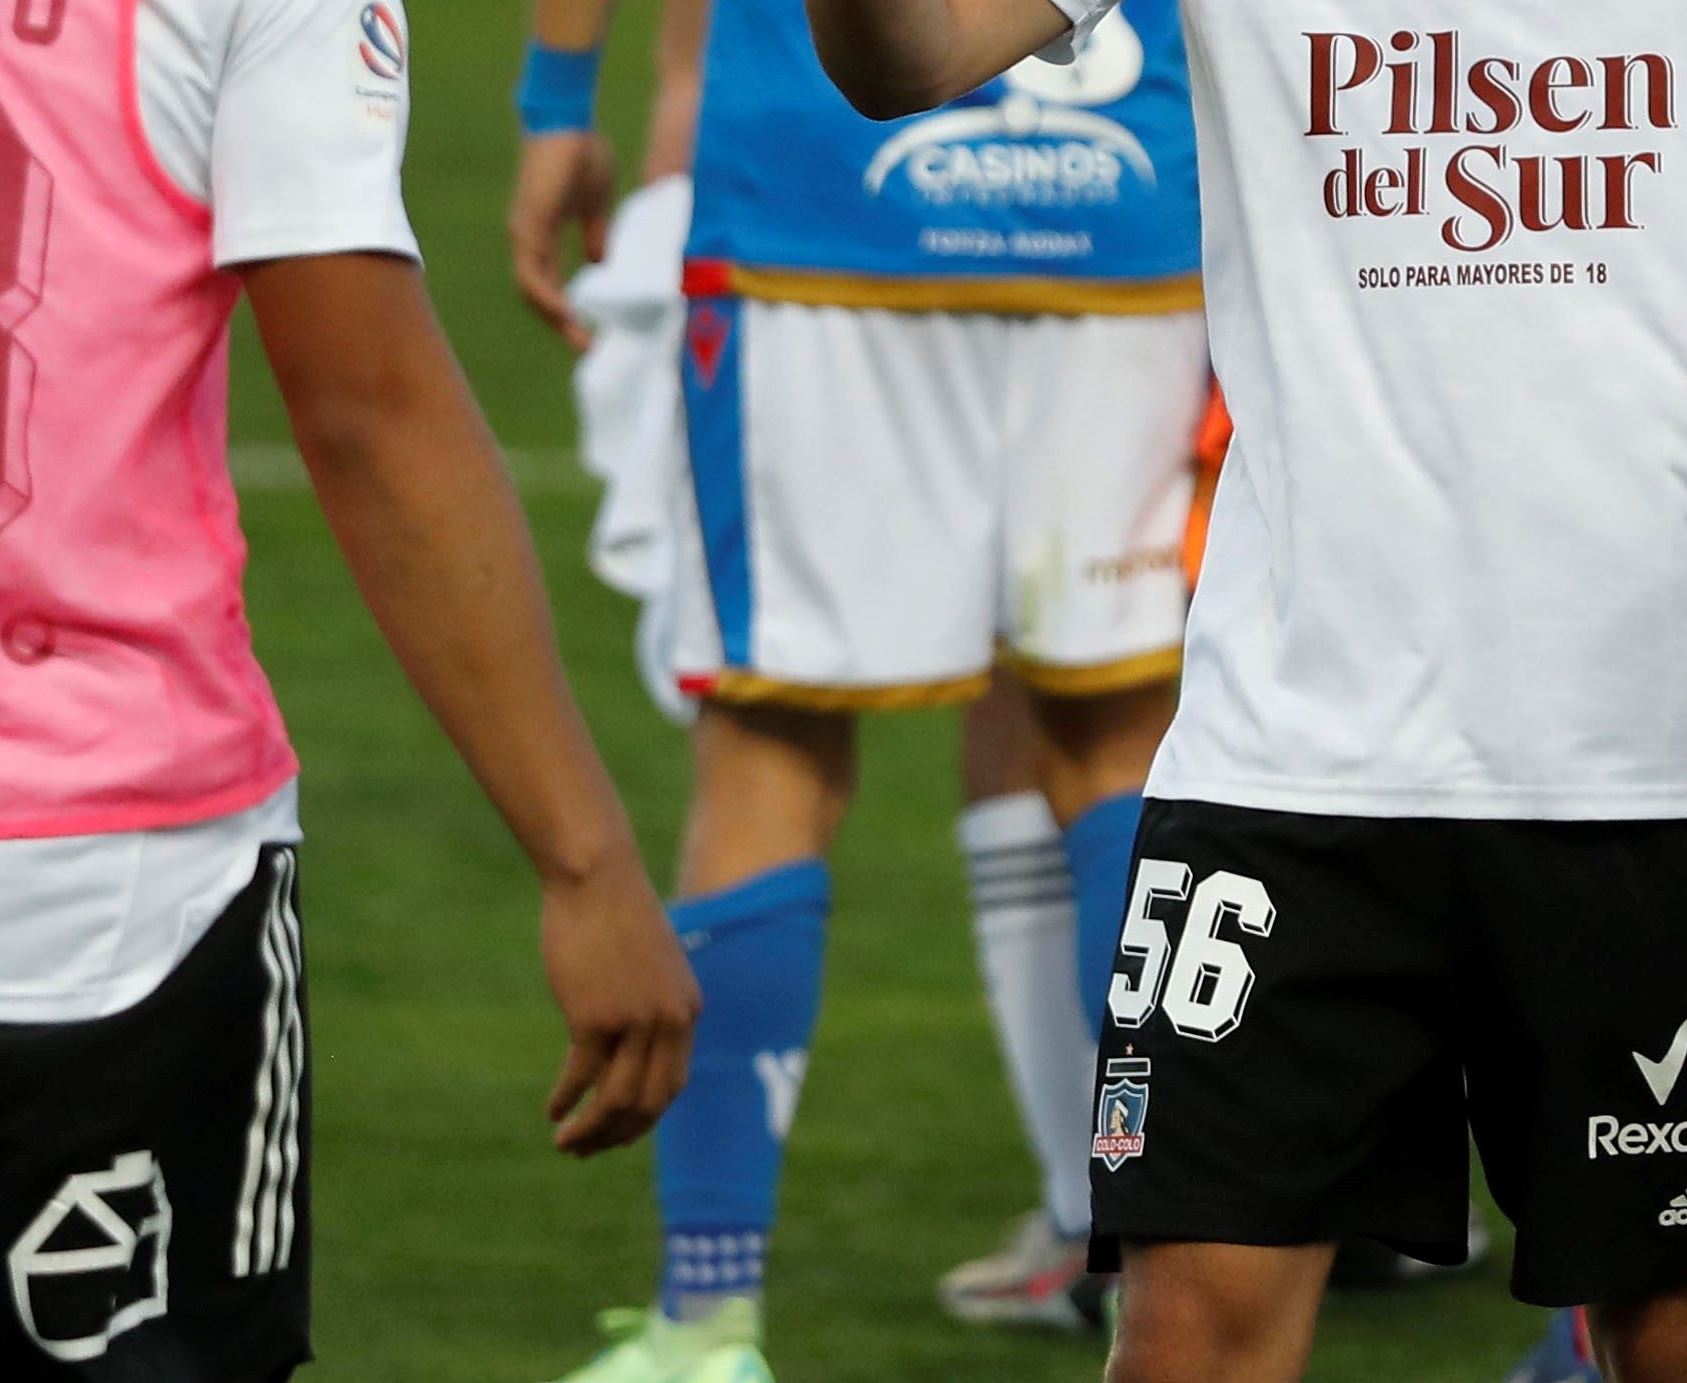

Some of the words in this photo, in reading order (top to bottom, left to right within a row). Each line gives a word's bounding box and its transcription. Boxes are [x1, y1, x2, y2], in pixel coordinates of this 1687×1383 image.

[1301, 29, 1678, 137] Pilsen
[907, 141, 1122, 194] CASINOS
[1323, 149, 1431, 219] del
[1441, 145, 1663, 252] Sur
[1358, 268, 1401, 289] SOLO
[1405, 266, 1451, 287] PARA
[1456, 264, 1545, 285] MAYORES
[1549, 263, 1574, 284] DE
[1586, 263, 1607, 284] 18
[1109, 859, 1276, 1043] 56
[1096, 1137, 1141, 1151] COLO-COLO
